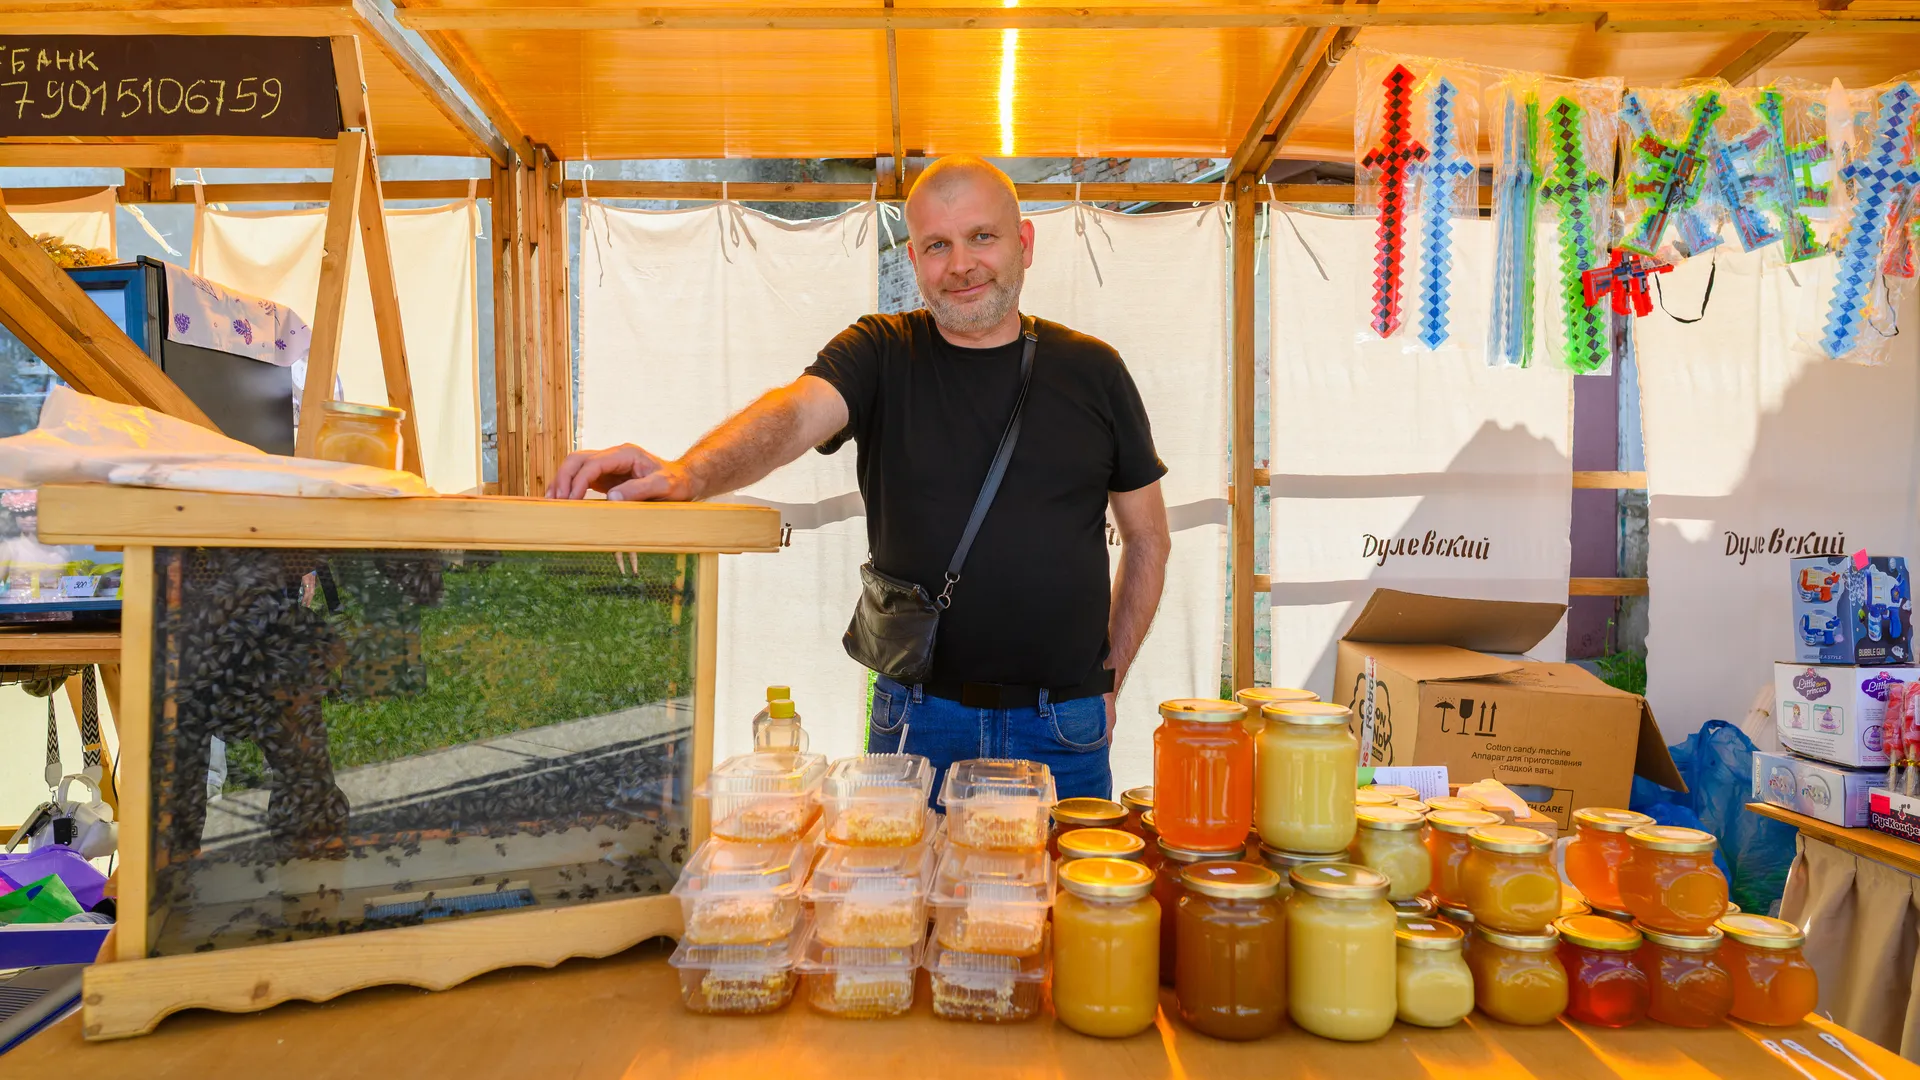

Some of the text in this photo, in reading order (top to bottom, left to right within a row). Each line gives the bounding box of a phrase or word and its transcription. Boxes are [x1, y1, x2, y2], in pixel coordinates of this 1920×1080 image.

[0, 45, 99, 75] БАНК
[1362, 529, 1491, 567] Дулевский
[1724, 527, 1846, 566] Дулевский
[1858, 647, 1876, 657] BUBBLE
[1796, 678, 1817, 690] Little
[1485, 742, 1572, 757] Cotton candy machine
[1471, 751, 1583, 768] Аппарат для приготовления
[1498, 764, 1555, 776] сладкой ваты
[1540, 804, 1564, 814] CARE
[1872, 813, 1920, 837] РусКонфе
